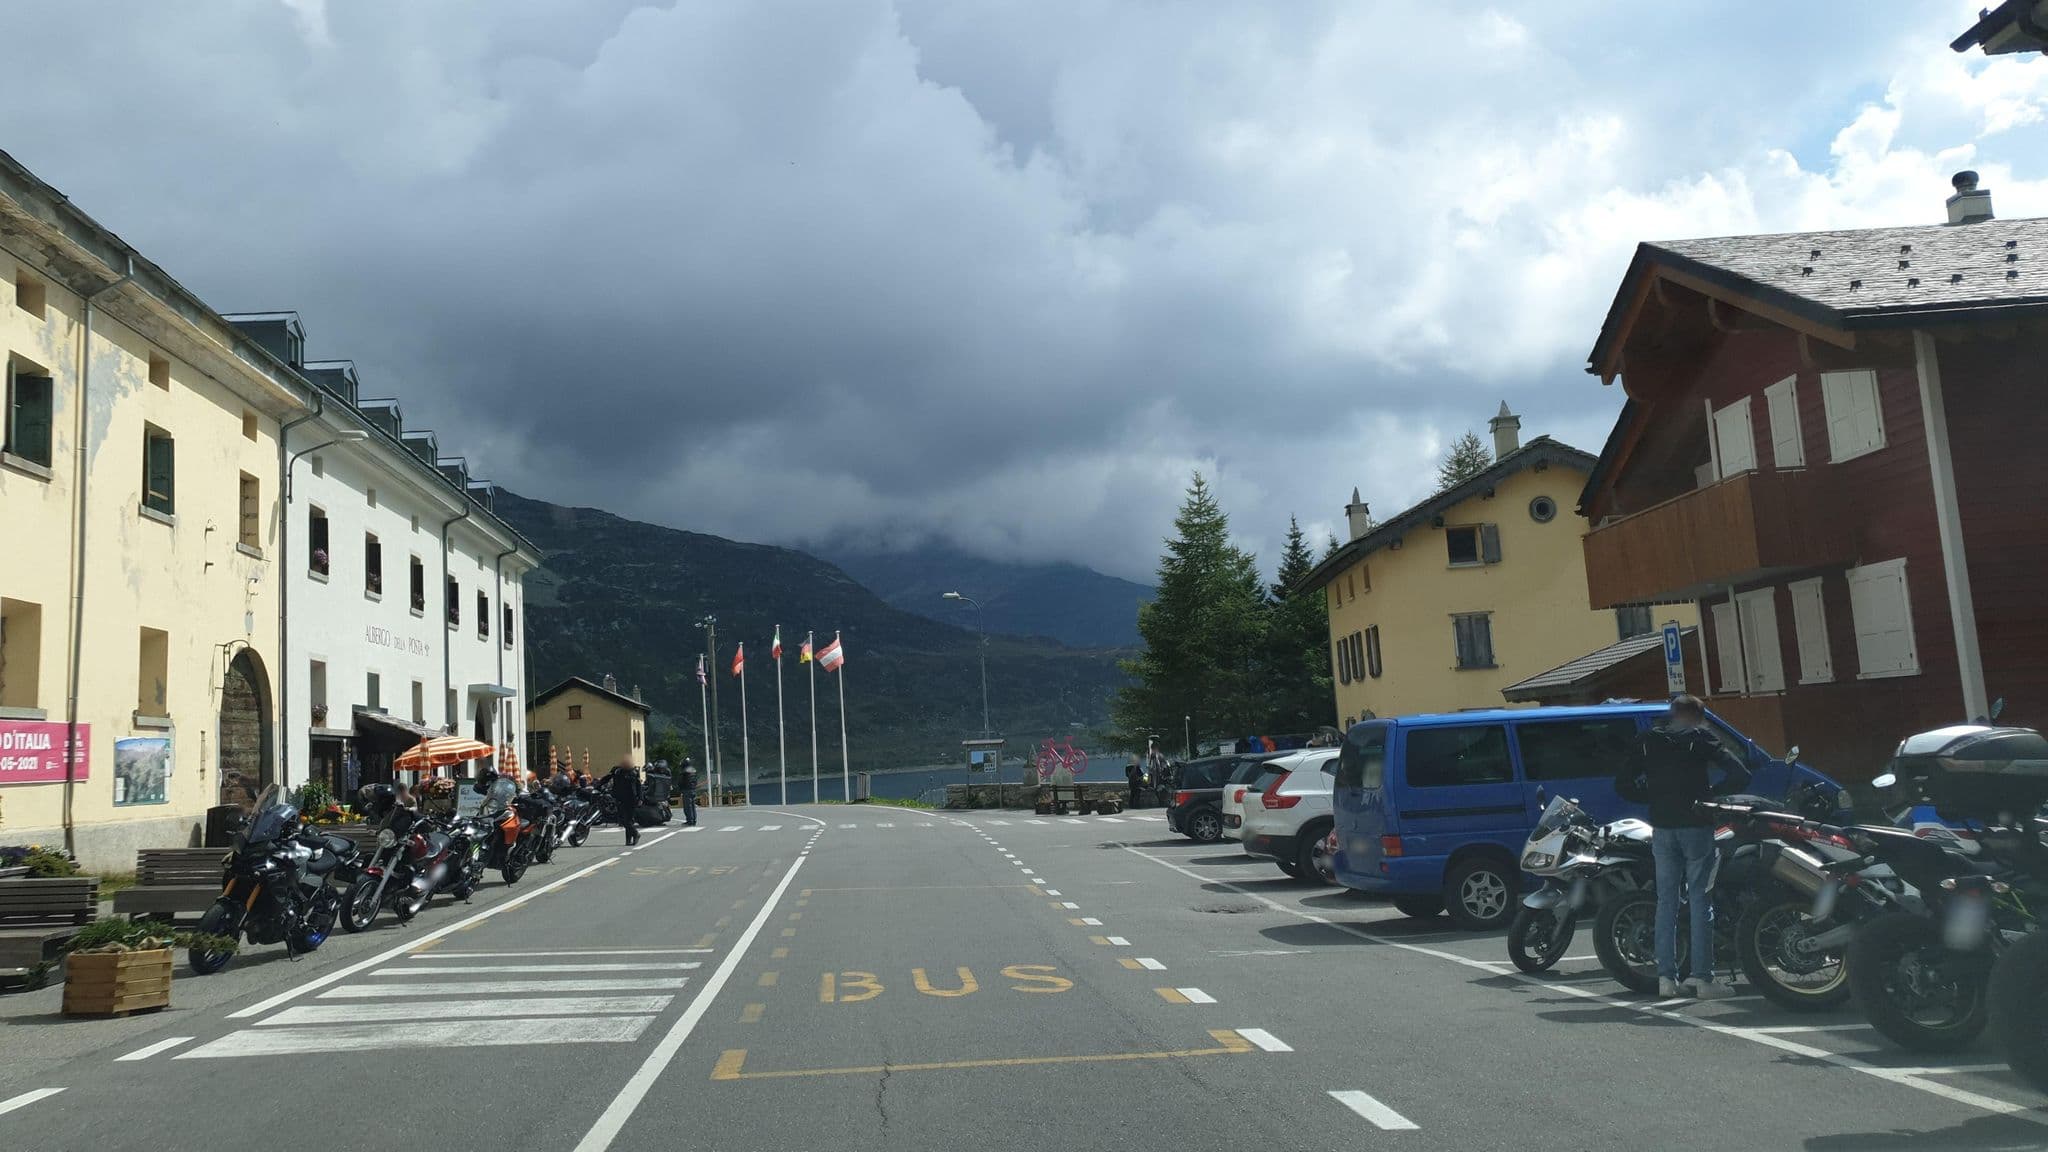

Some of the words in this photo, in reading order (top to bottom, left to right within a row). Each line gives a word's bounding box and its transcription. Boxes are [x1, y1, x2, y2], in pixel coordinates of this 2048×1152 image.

[366, 625, 390, 647] ALBERGO
[1667, 632, 1677, 659] P
[3, 730, 51, 750] D'ITALIA
[820, 965, 1073, 1002] BUS
